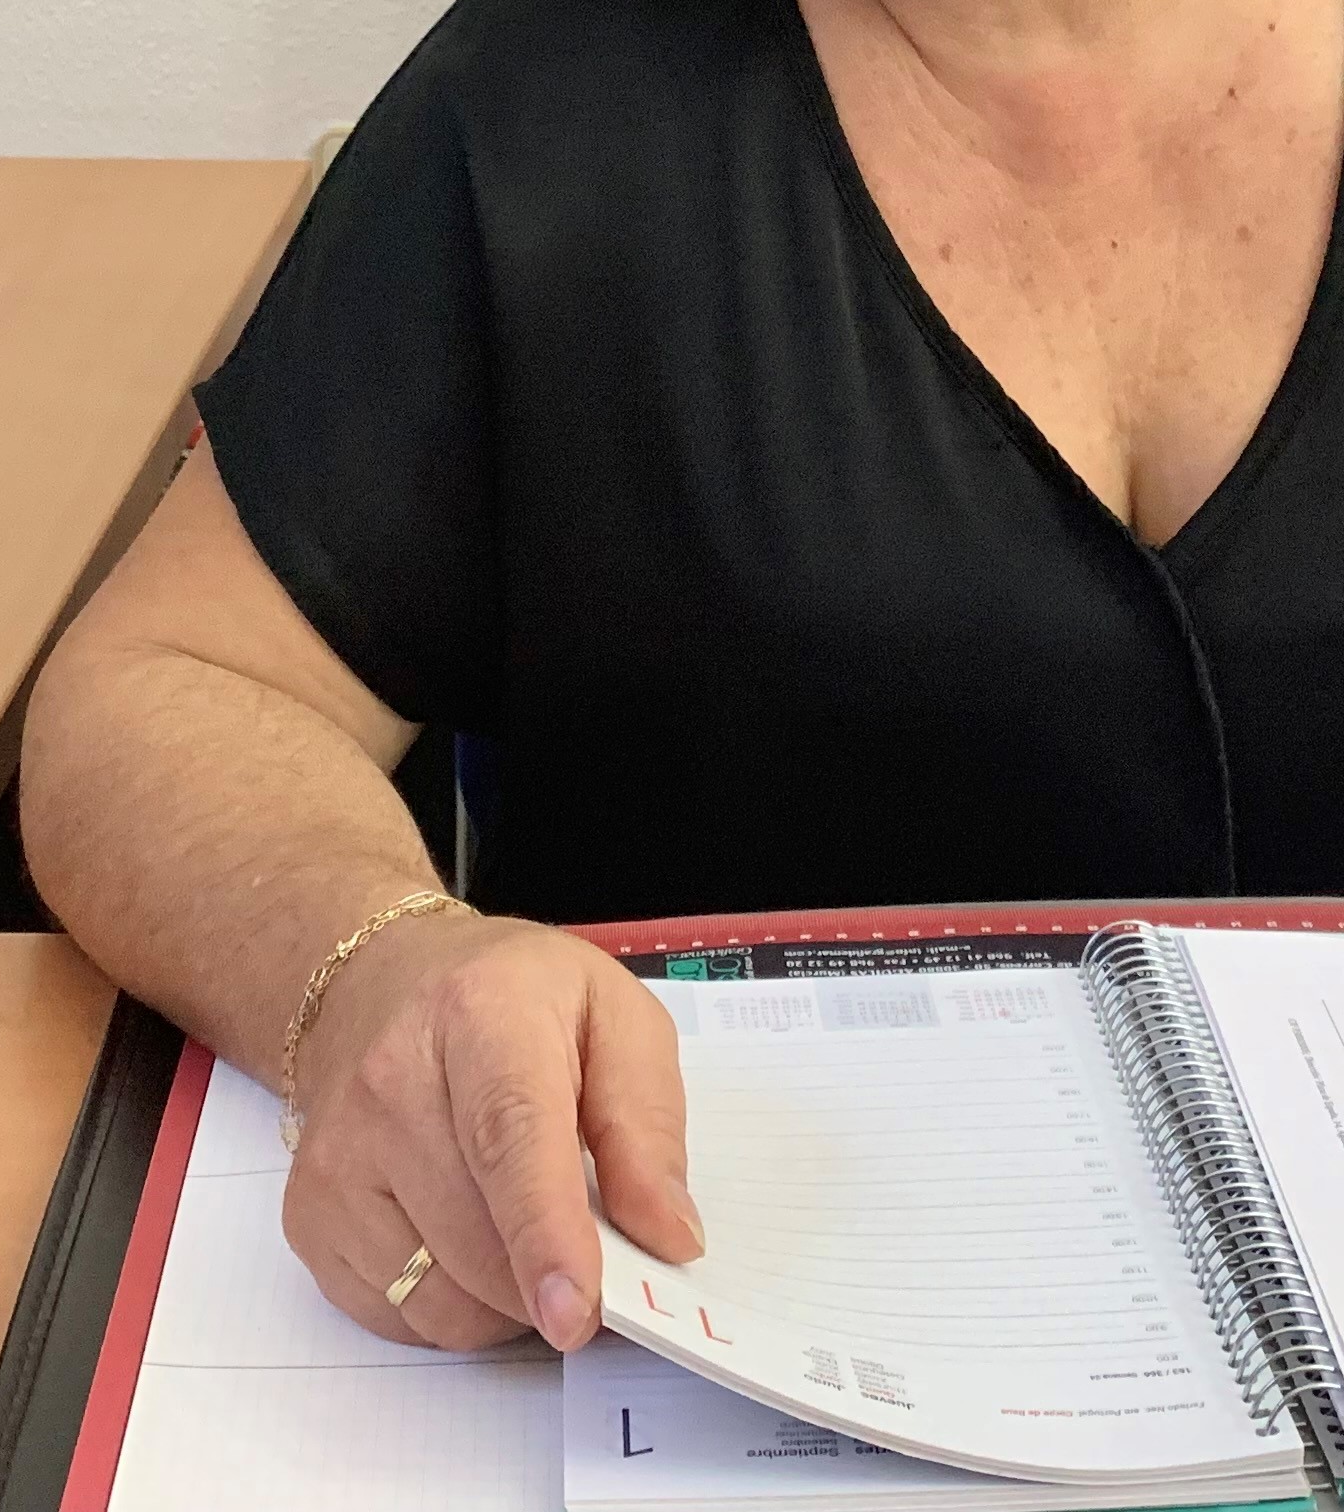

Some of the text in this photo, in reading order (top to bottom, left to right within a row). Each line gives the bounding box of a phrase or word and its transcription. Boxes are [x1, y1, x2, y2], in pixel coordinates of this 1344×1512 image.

[884, 958, 907, 966] Fax
[860, 1392, 915, 1411] Jueves
[622, 1407, 654, 1458] 1
[746, 1446, 840, 1460] Septiembre
